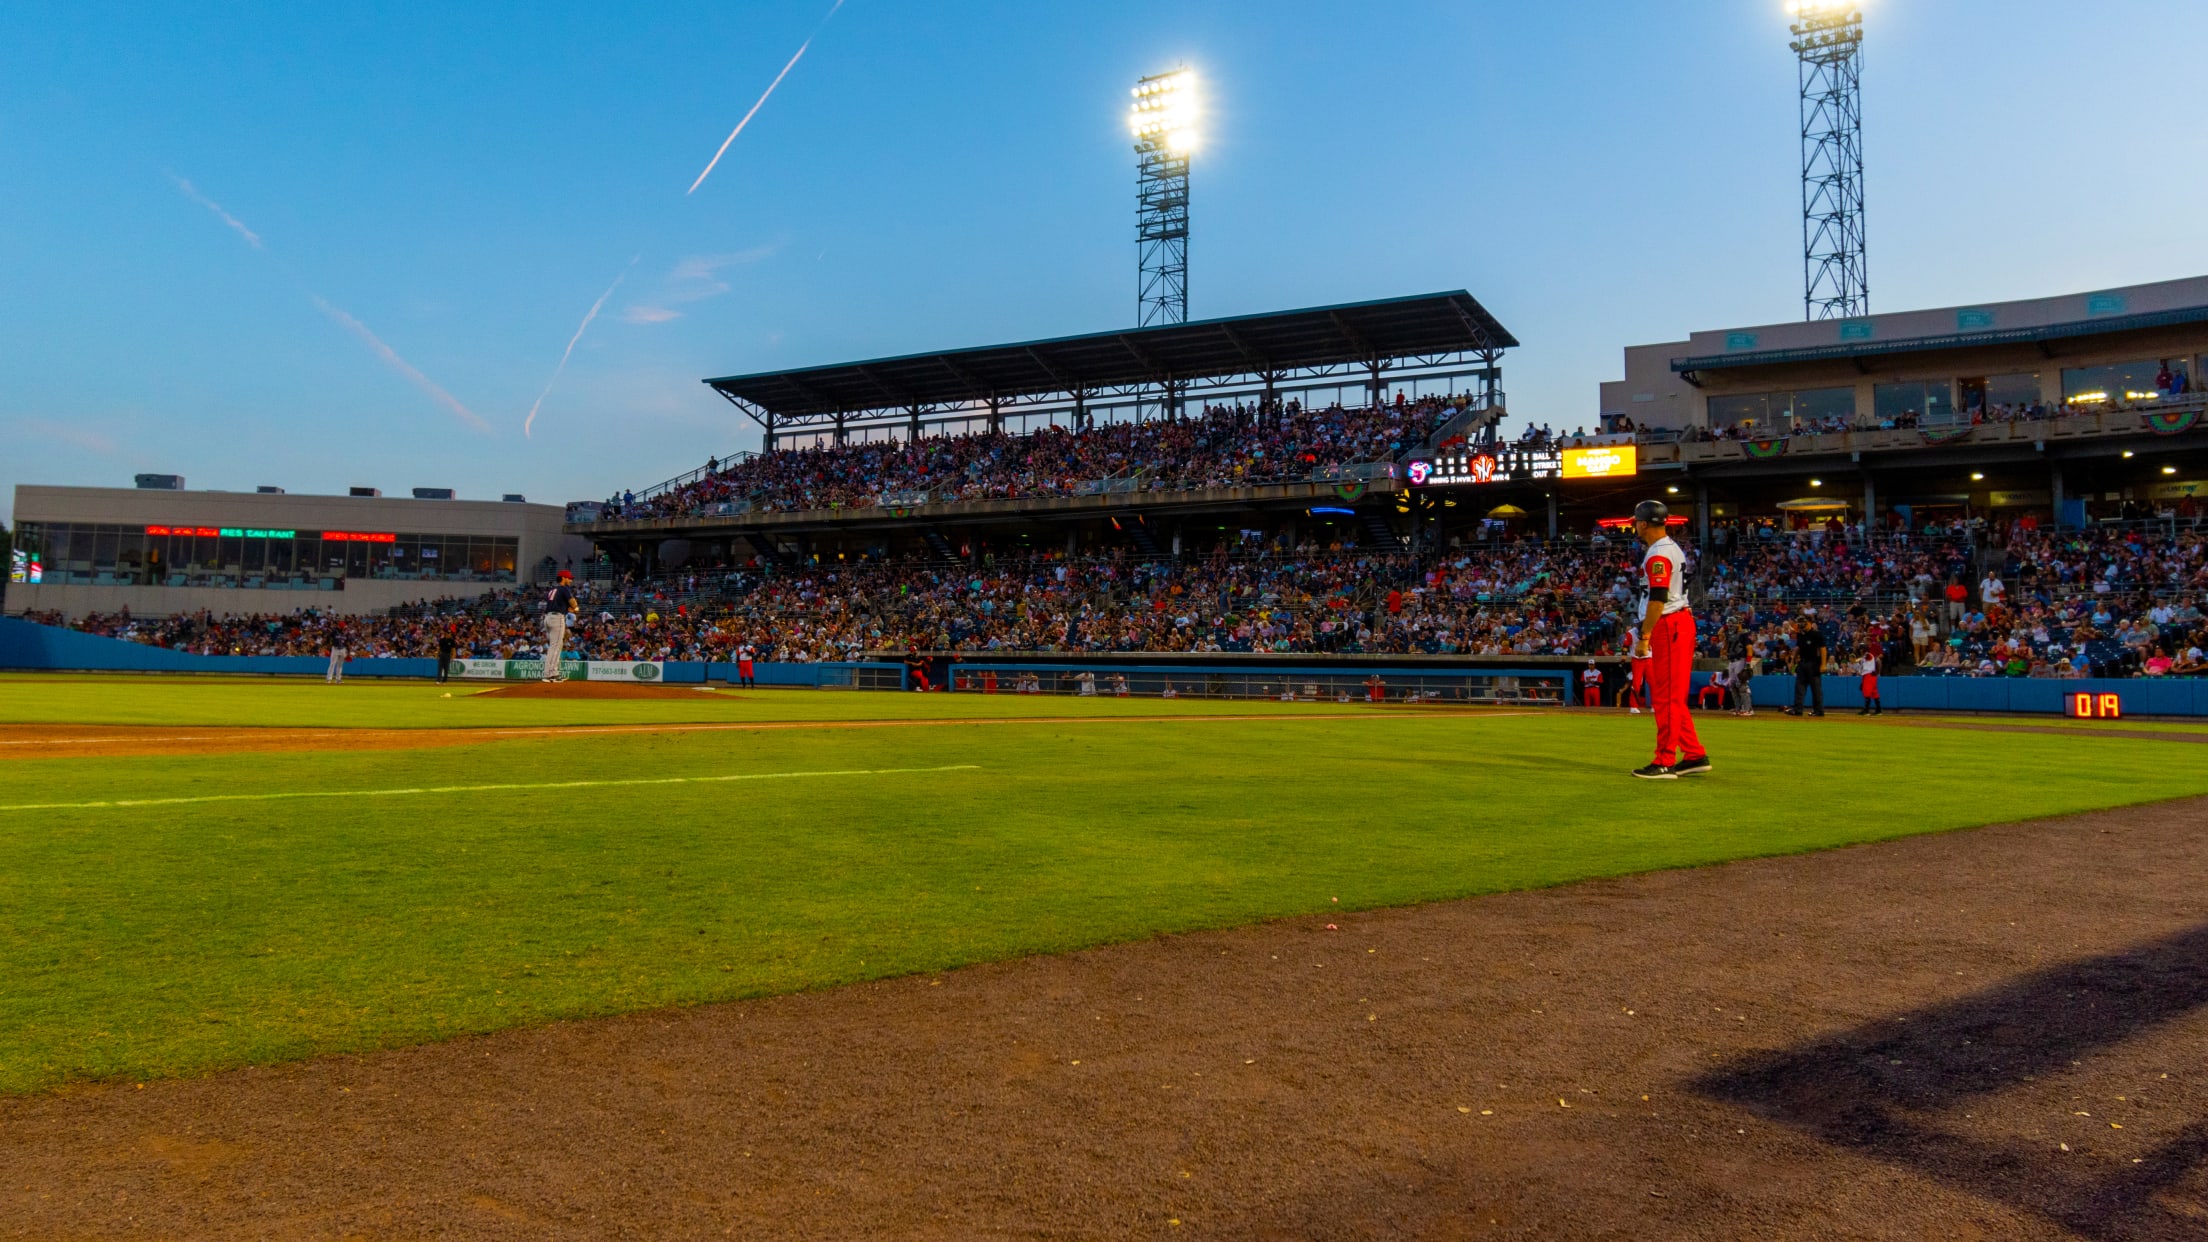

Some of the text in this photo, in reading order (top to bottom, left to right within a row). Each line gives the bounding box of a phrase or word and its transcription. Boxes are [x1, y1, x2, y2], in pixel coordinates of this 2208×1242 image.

[1532, 452, 1551, 460] BALL
[1532, 461, 1557, 469] STRIKE
[1576, 455, 1620, 467] MANGO
[1497, 463, 1504, 471] 4
[1510, 462, 1517, 470] 7
[1533, 470, 1548, 478] OUT
[560, 661, 580, 670] LAWN
